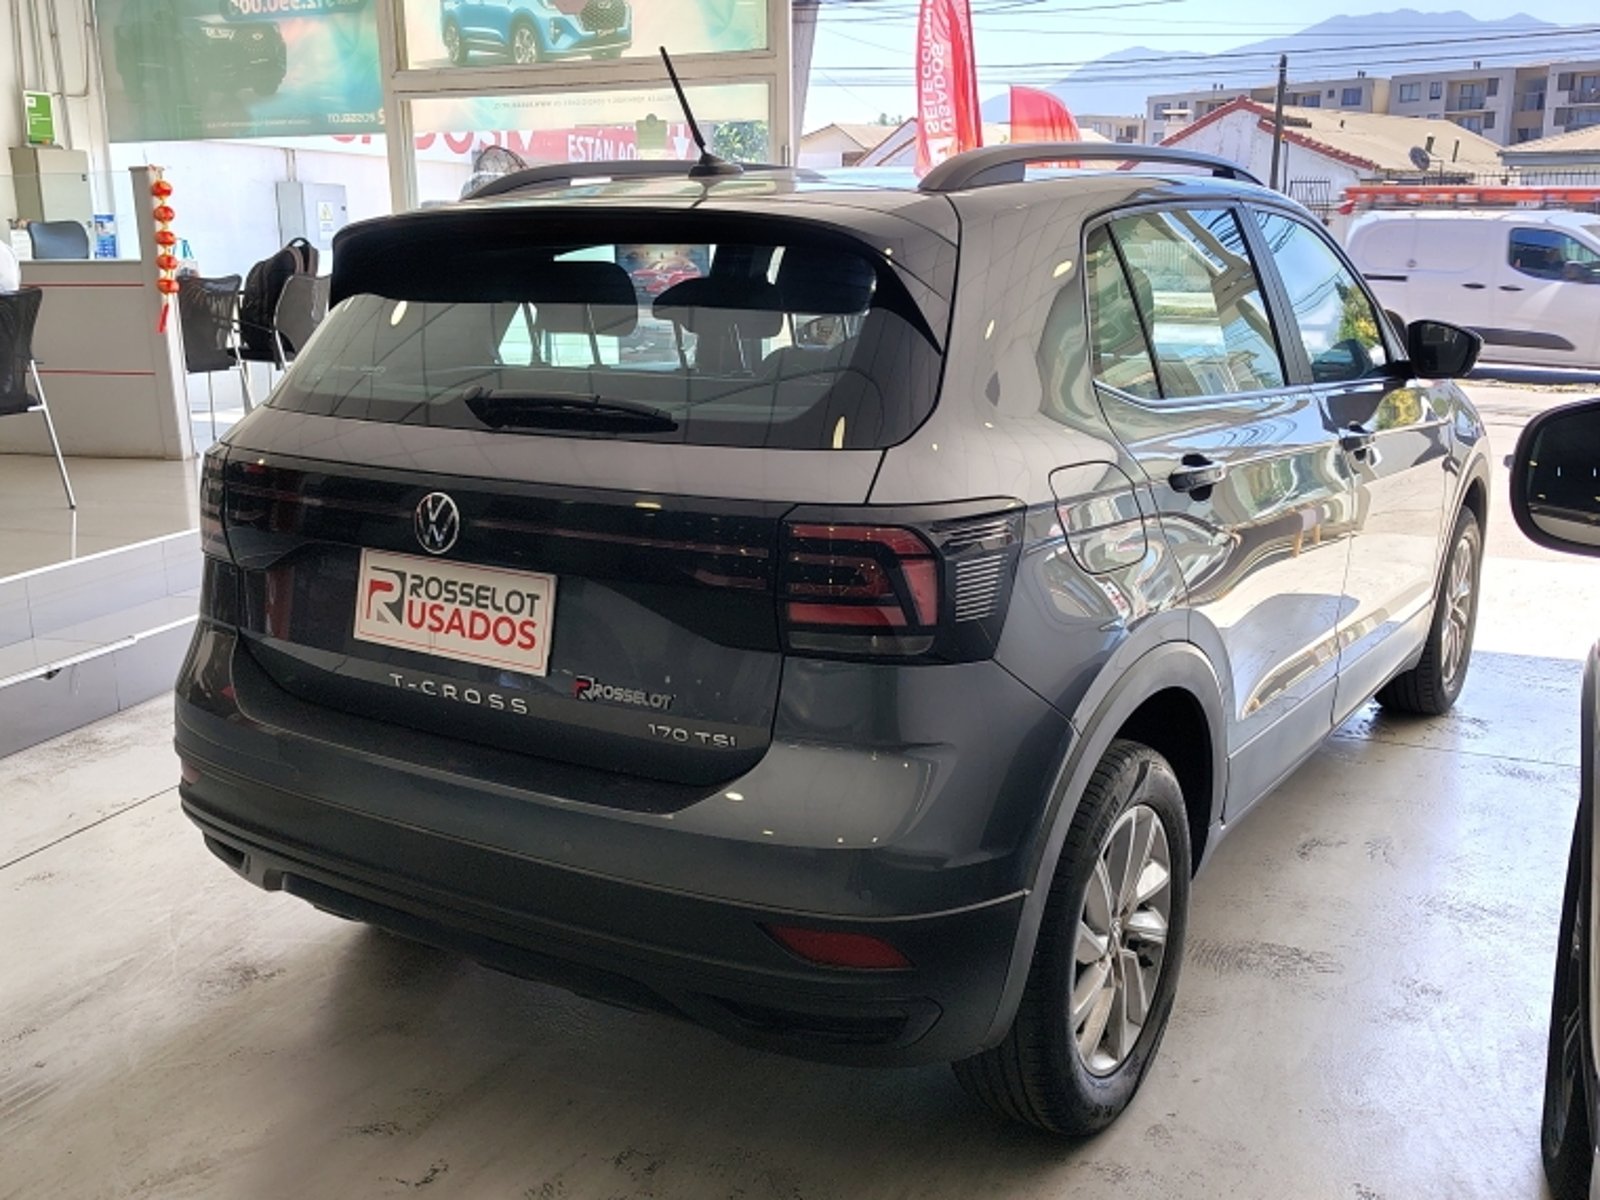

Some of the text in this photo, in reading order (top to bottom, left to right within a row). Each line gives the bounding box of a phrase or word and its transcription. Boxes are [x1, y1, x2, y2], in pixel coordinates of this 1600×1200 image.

[409, 574, 541, 617] ROSSELOT
[407, 599, 537, 650] USADOS
[389, 672, 528, 714] T-CROSS
[594, 684, 673, 710] ROSSELOT
[648, 723, 738, 748] 170 TSI
